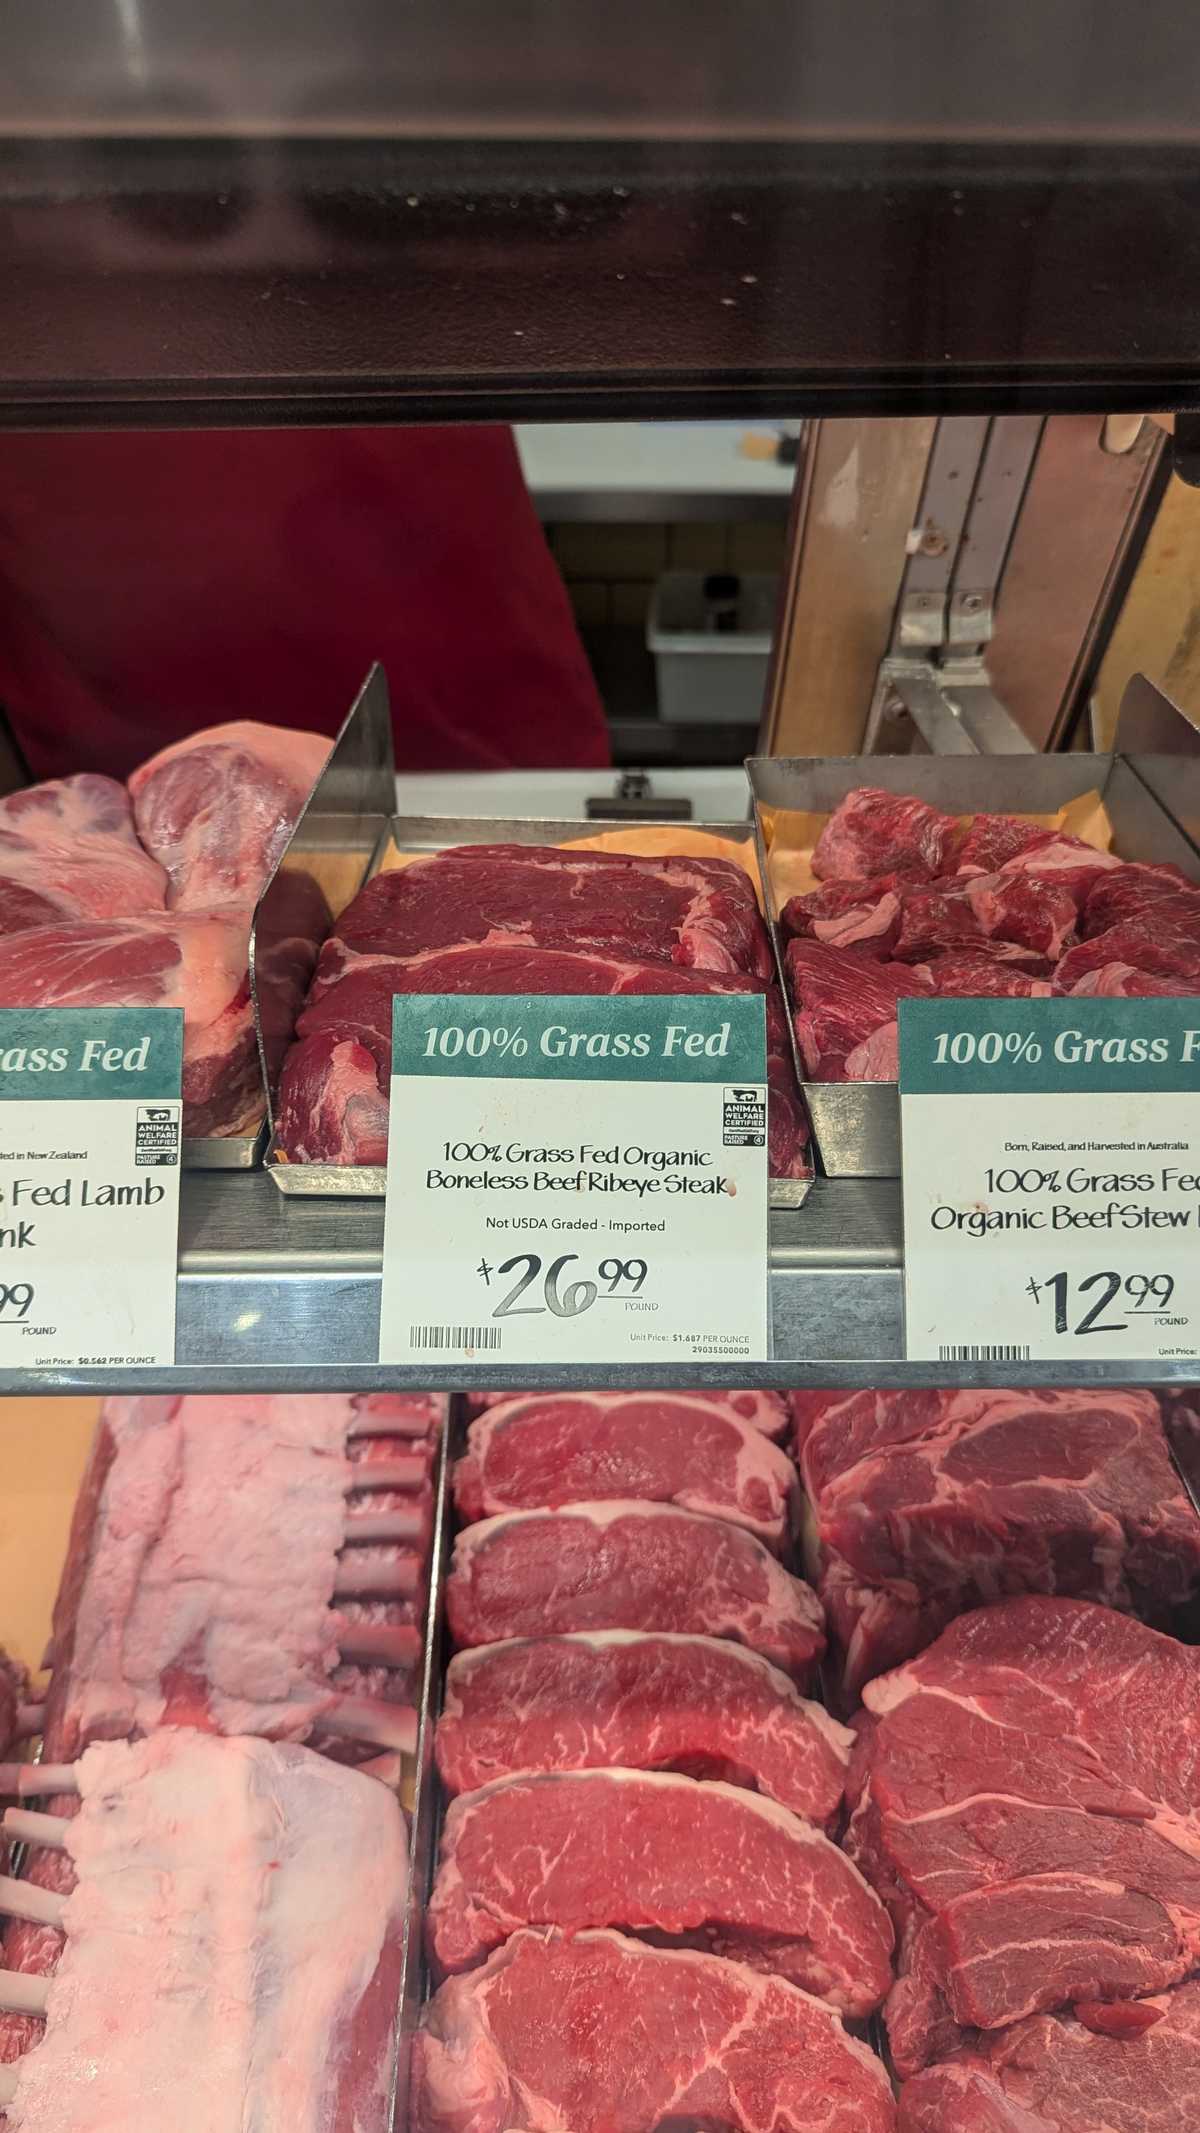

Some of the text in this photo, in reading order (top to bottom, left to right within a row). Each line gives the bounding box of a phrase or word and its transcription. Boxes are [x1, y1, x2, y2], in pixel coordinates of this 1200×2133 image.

[421, 1022, 731, 1058] 100% Grass Fed
[932, 1031, 1042, 1064] 100%
[1053, 1030, 1169, 1063] Grass
[0, 1036, 152, 1072] ass Fed
[725, 1104, 764, 1113] ANIMAL
[725, 1112, 764, 1120] WELFARE
[724, 1119, 764, 1127] CERTIFIED
[138, 1124, 177, 1132] ANIMAL
[1004, 1142, 1189, 1151] Born, Raised, and Harvested in Australia
[16, 1152, 25, 1160] in
[27, 1152, 48, 1160] New
[48, 1151, 88, 1160] Zealand
[443, 1142, 713, 1171] 100% Grass Fed Organic
[426, 1169, 729, 1198] Boneless Beef Ribeye Steak
[984, 1168, 1062, 1193] 100%
[1066, 1167, 1155, 1193] Grass
[12, 1179, 71, 1206] Fed
[81, 1177, 165, 1206] Lamb
[930, 1206, 1047, 1237] Organic
[1052, 1203, 1120, 1230] Beef
[1119, 1205, 1191, 1228] Stew
[486, 1217, 509, 1229] Not
[512, 1217, 548, 1230] USDA
[551, 1218, 598, 1230] Graded
[609, 1220, 665, 1233] Imported
[625, 1302, 659, 1311] POUND
[1154, 1317, 1188, 1326] POUND
[22, 1326, 57, 1335] POUND
[630, 1333, 750, 1344] Unit Price: $1.687 PER OUNCE
[691, 1346, 750, 1354] 29035500000
[35, 1356, 156, 1365] Unit Price: $0.562 PER OUNCE
